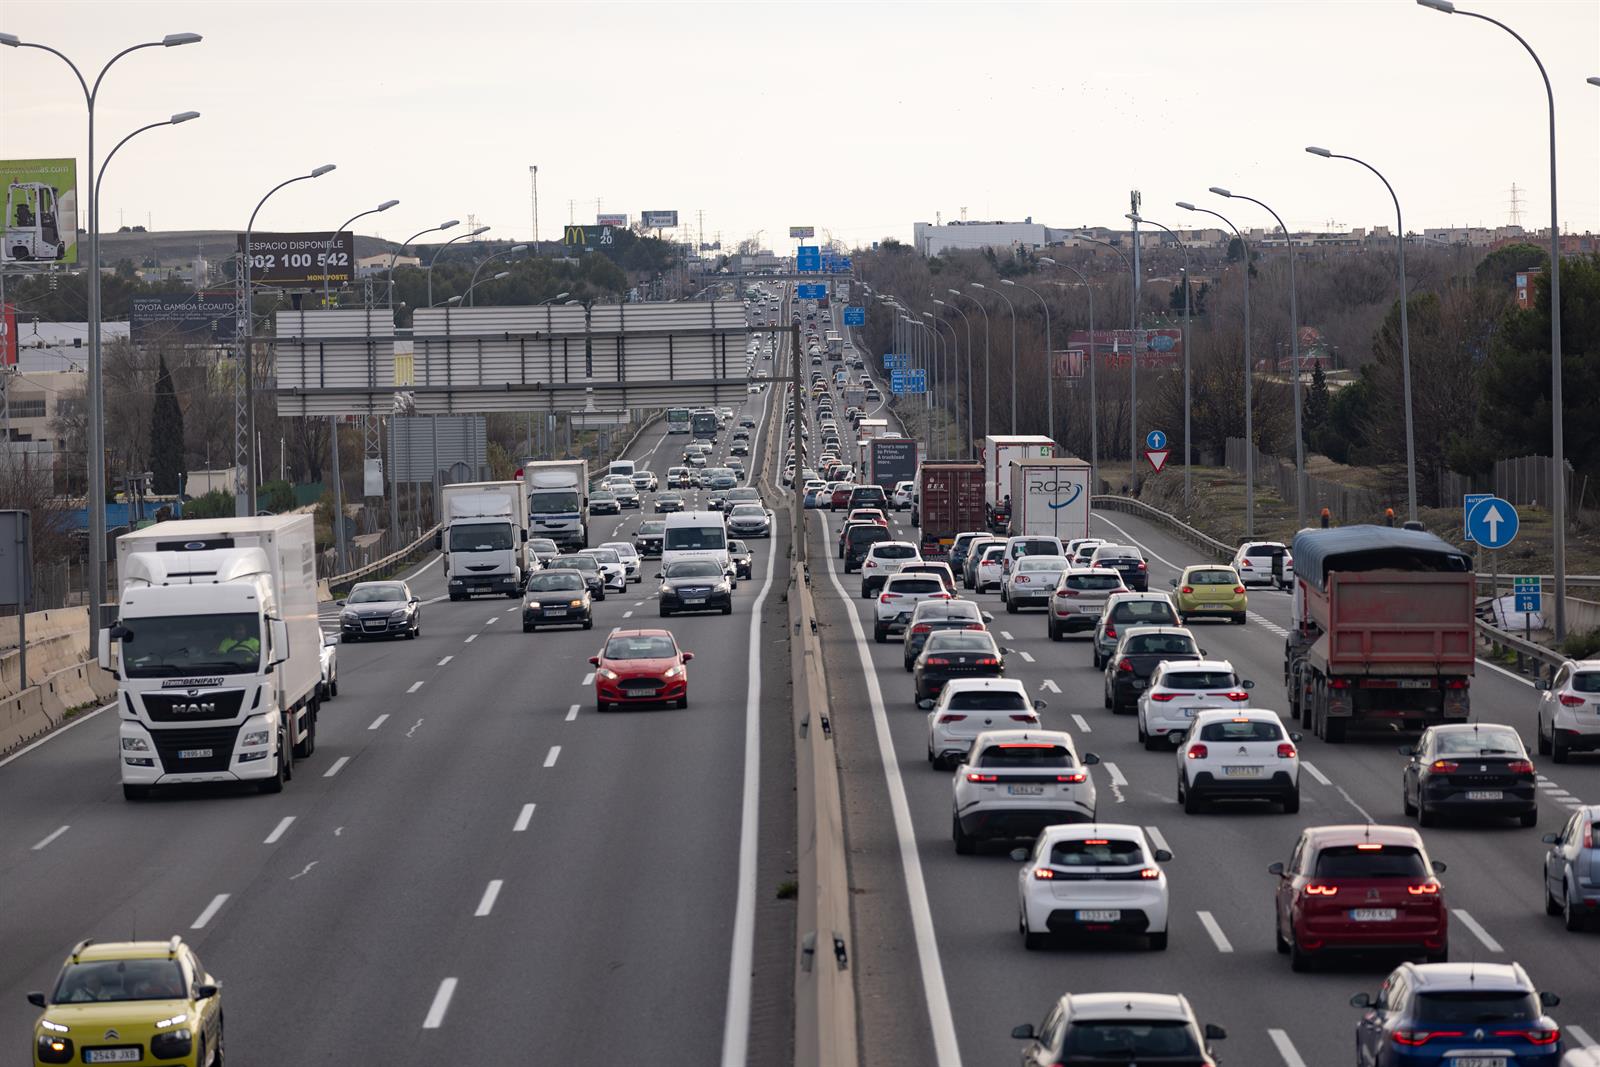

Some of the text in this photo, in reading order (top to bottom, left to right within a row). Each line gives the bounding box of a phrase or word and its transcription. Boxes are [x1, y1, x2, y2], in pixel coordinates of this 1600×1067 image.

[600, 236, 613, 244] 20
[248, 240, 344, 251] ESPACIO DISPONIBLE
[281, 253, 312, 267] 100
[316, 252, 349, 267] 542
[133, 303, 162, 311] TOYOTA
[163, 303, 197, 311] GAMBOA
[1041, 447, 1049, 456] 4
[1029, 481, 1072, 493] ROR
[1522, 602, 1534, 610] 18
[172, 703, 216, 713] MAN
[93, 1049, 136, 1060] 2549 JXB
